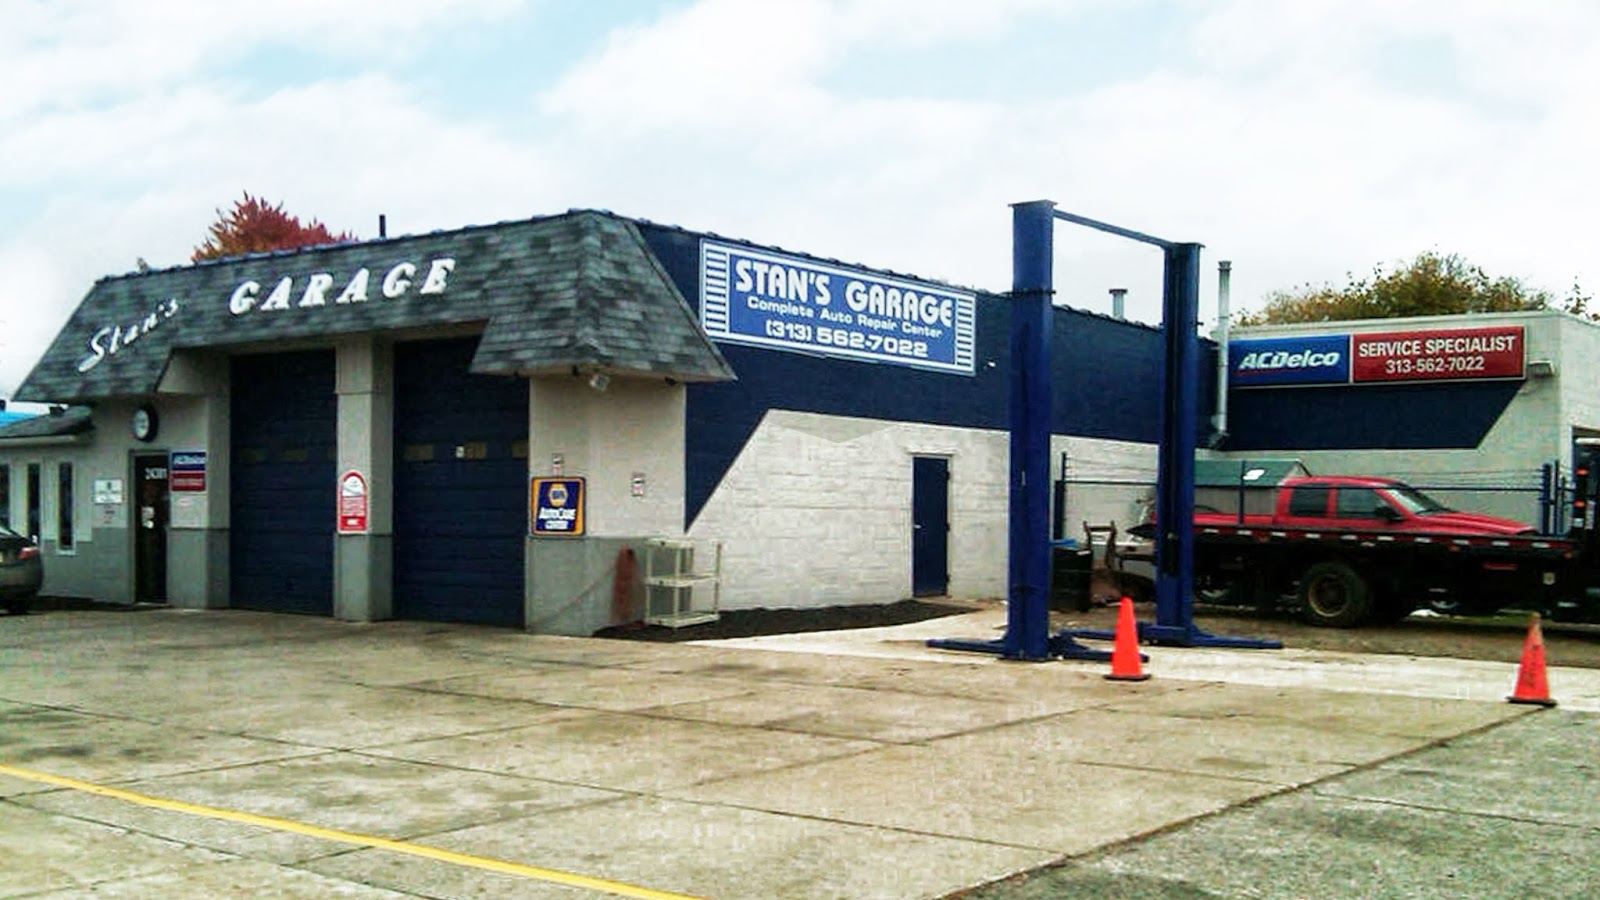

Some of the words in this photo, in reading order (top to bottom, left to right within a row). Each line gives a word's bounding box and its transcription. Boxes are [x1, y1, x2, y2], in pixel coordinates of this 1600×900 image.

[735, 258, 831, 306] STAN'S
[845, 281, 953, 328] GARAGE
[79, 298, 179, 372] Stan's
[229, 258, 456, 315] GARAGE
[747, 296, 815, 319] Complete
[819, 307, 854, 325] Auto
[857, 315, 898, 332] Repair
[901, 320, 943, 338] Center
[765, 319, 812, 341] (313)
[816, 326, 929, 358] 562-7022
[1358, 339, 1421, 358] SERVICE
[1425, 335, 1516, 355] SPECIALIST
[1238, 349, 1340, 370] ACDelco
[1385, 355, 1485, 375] 313-562-7022
